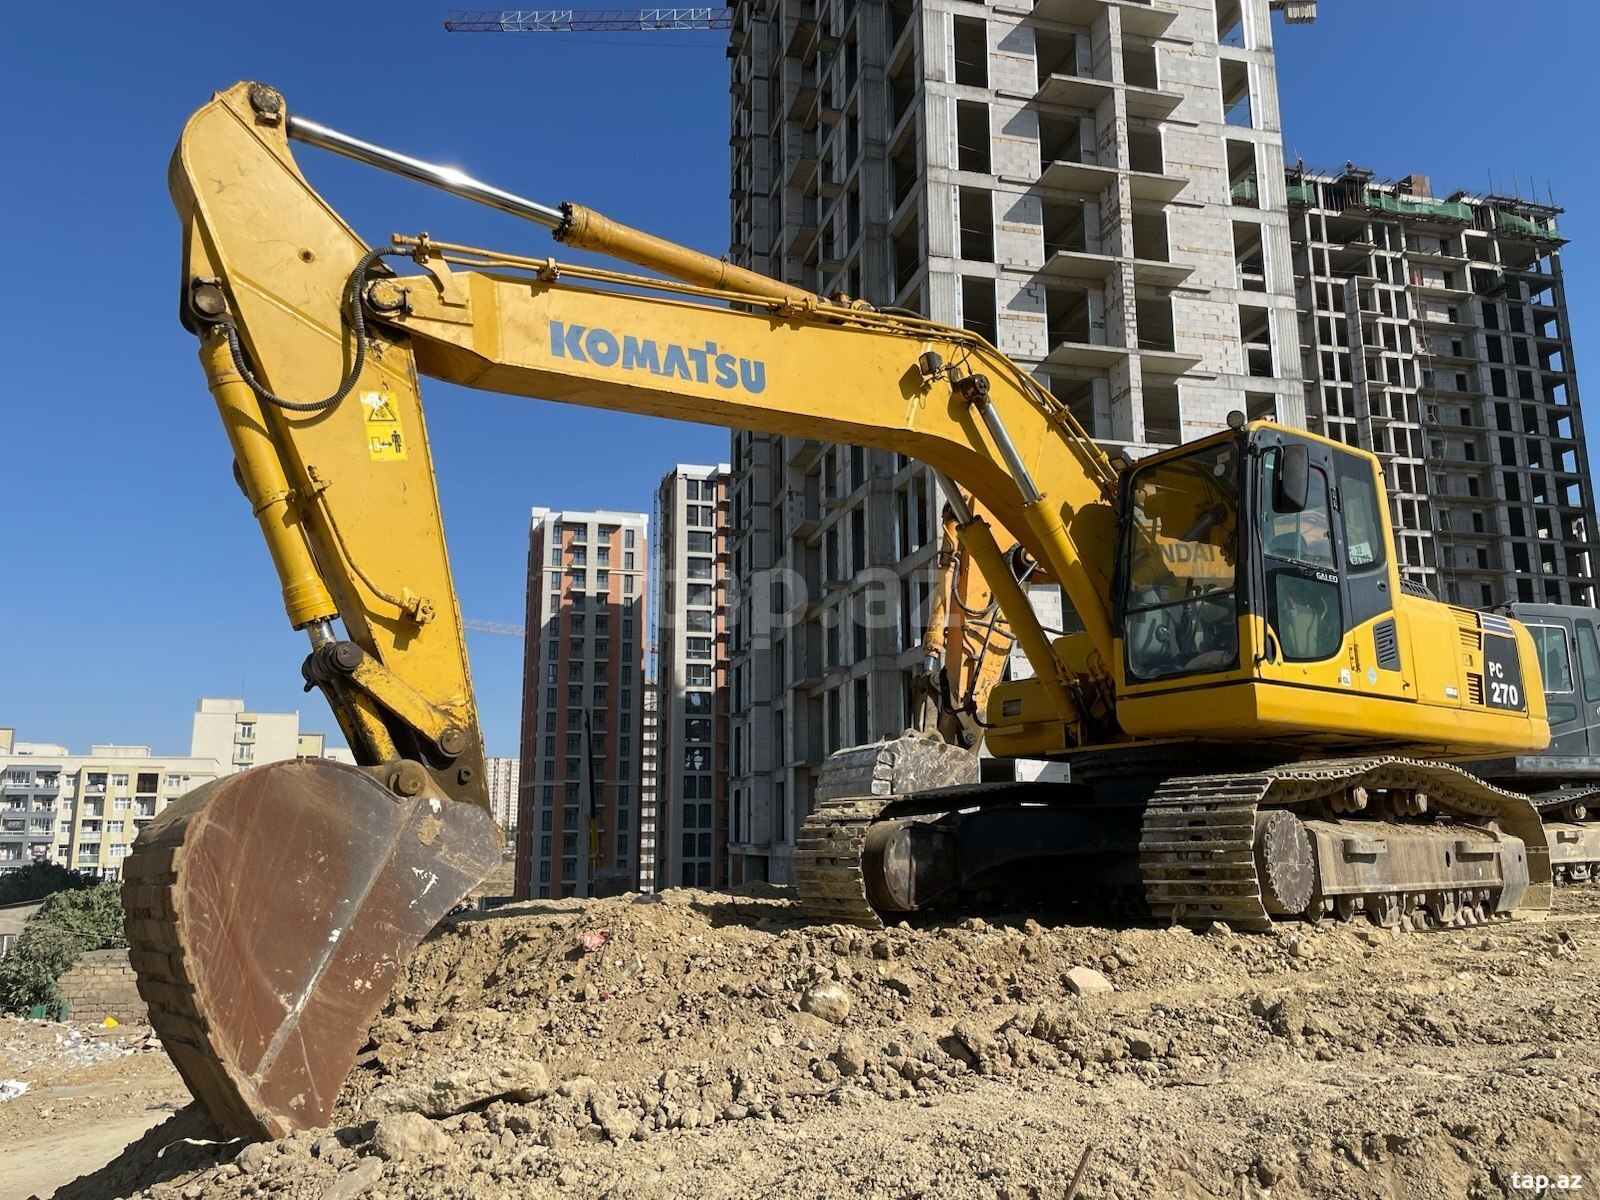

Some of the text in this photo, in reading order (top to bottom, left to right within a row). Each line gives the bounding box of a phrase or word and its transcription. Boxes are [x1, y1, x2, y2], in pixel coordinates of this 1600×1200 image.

[549, 320, 766, 394] KOMATSU
[1488, 661, 1504, 679] PC
[1490, 682, 1519, 706] 270
